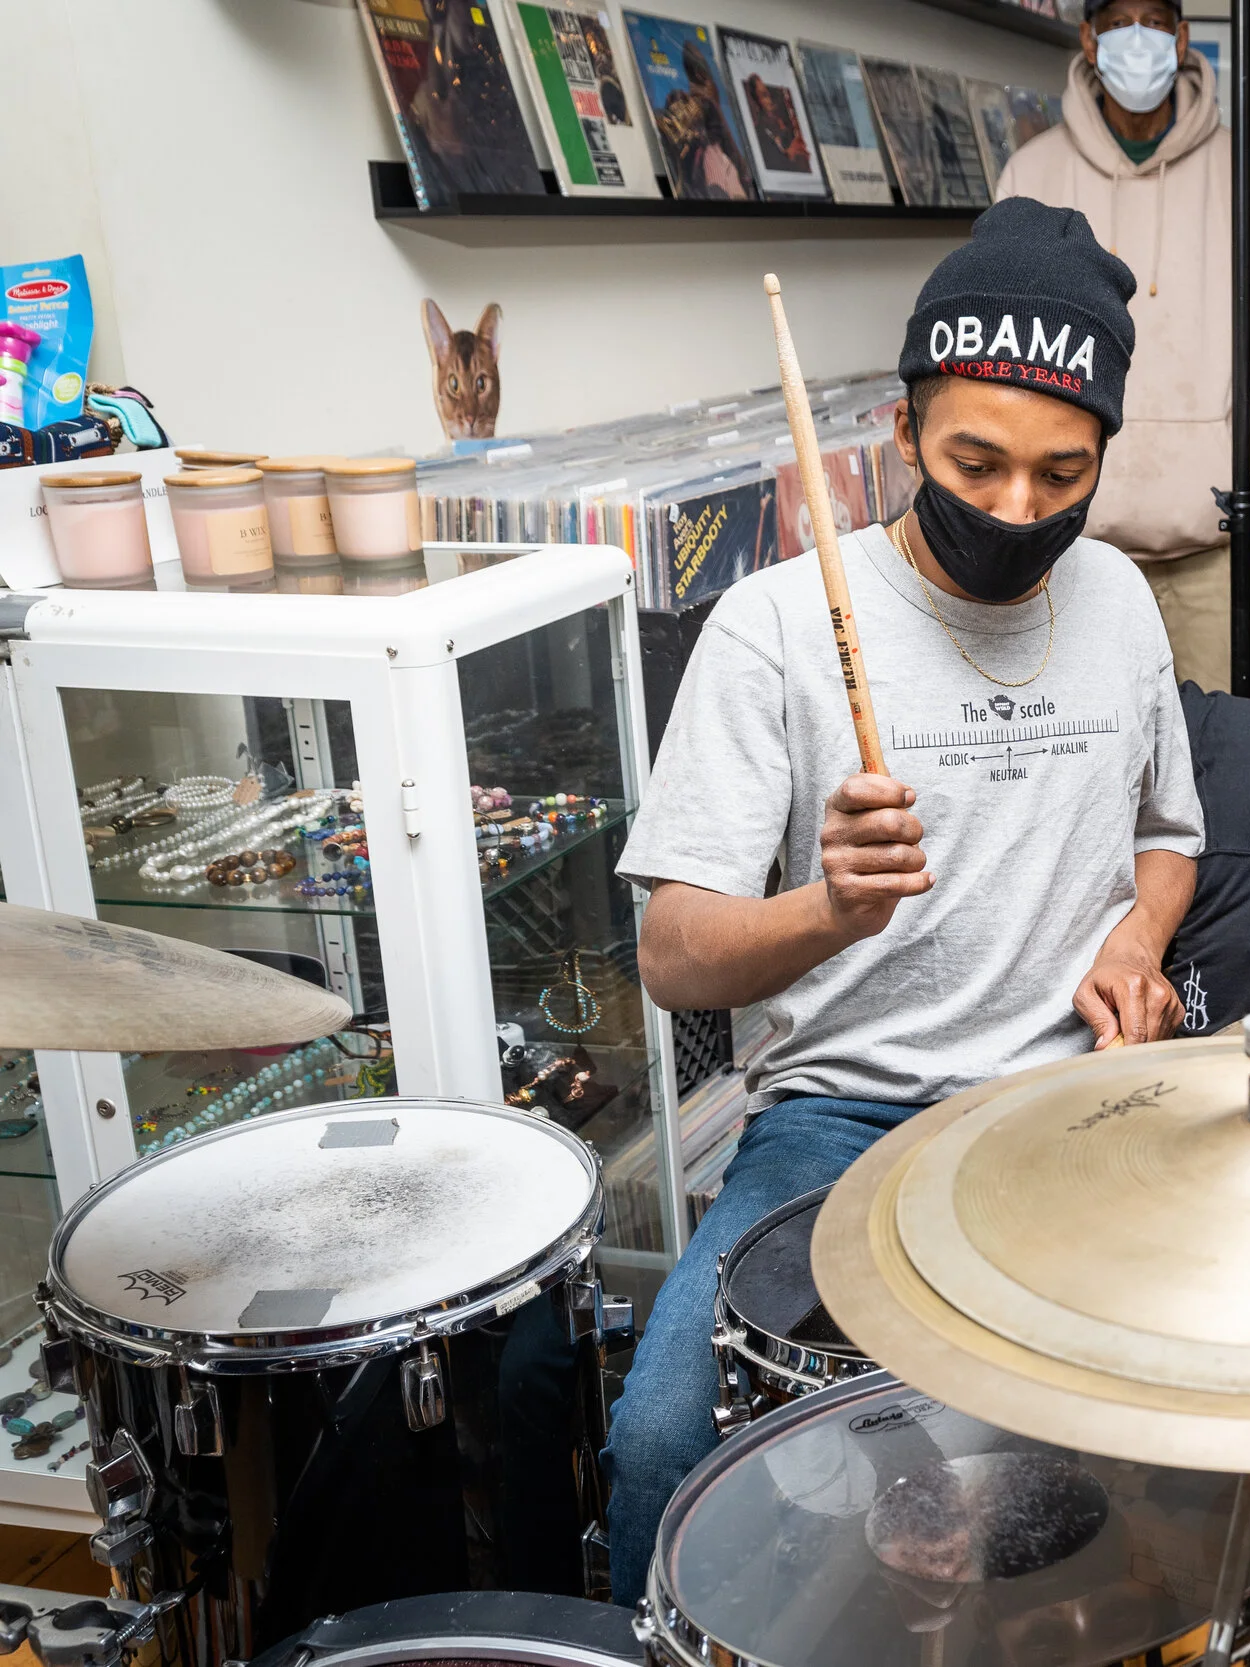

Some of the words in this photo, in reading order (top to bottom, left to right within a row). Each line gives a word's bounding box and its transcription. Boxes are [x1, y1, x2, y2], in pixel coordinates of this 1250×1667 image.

[930, 314, 1095, 381] OBAMA
[951, 361, 1012, 377] MORE
[1017, 364, 1083, 393] YEARS
[673, 512, 688, 535] Roy
[674, 504, 712, 570] UBIQUITY
[675, 504, 728, 599] STARBOOTY
[830, 606, 845, 634] VIC
[837, 641, 858, 692] FIRTH
[961, 703, 988, 723] The
[1020, 695, 1056, 719] scale
[939, 753, 969, 767] ACIDIC
[1051, 741, 1088, 756] ALKALINE
[990, 768, 1028, 782] NEUTRAL
[137, 1273, 180, 1297] REMO
[855, 1412, 903, 1430] Ludwig
